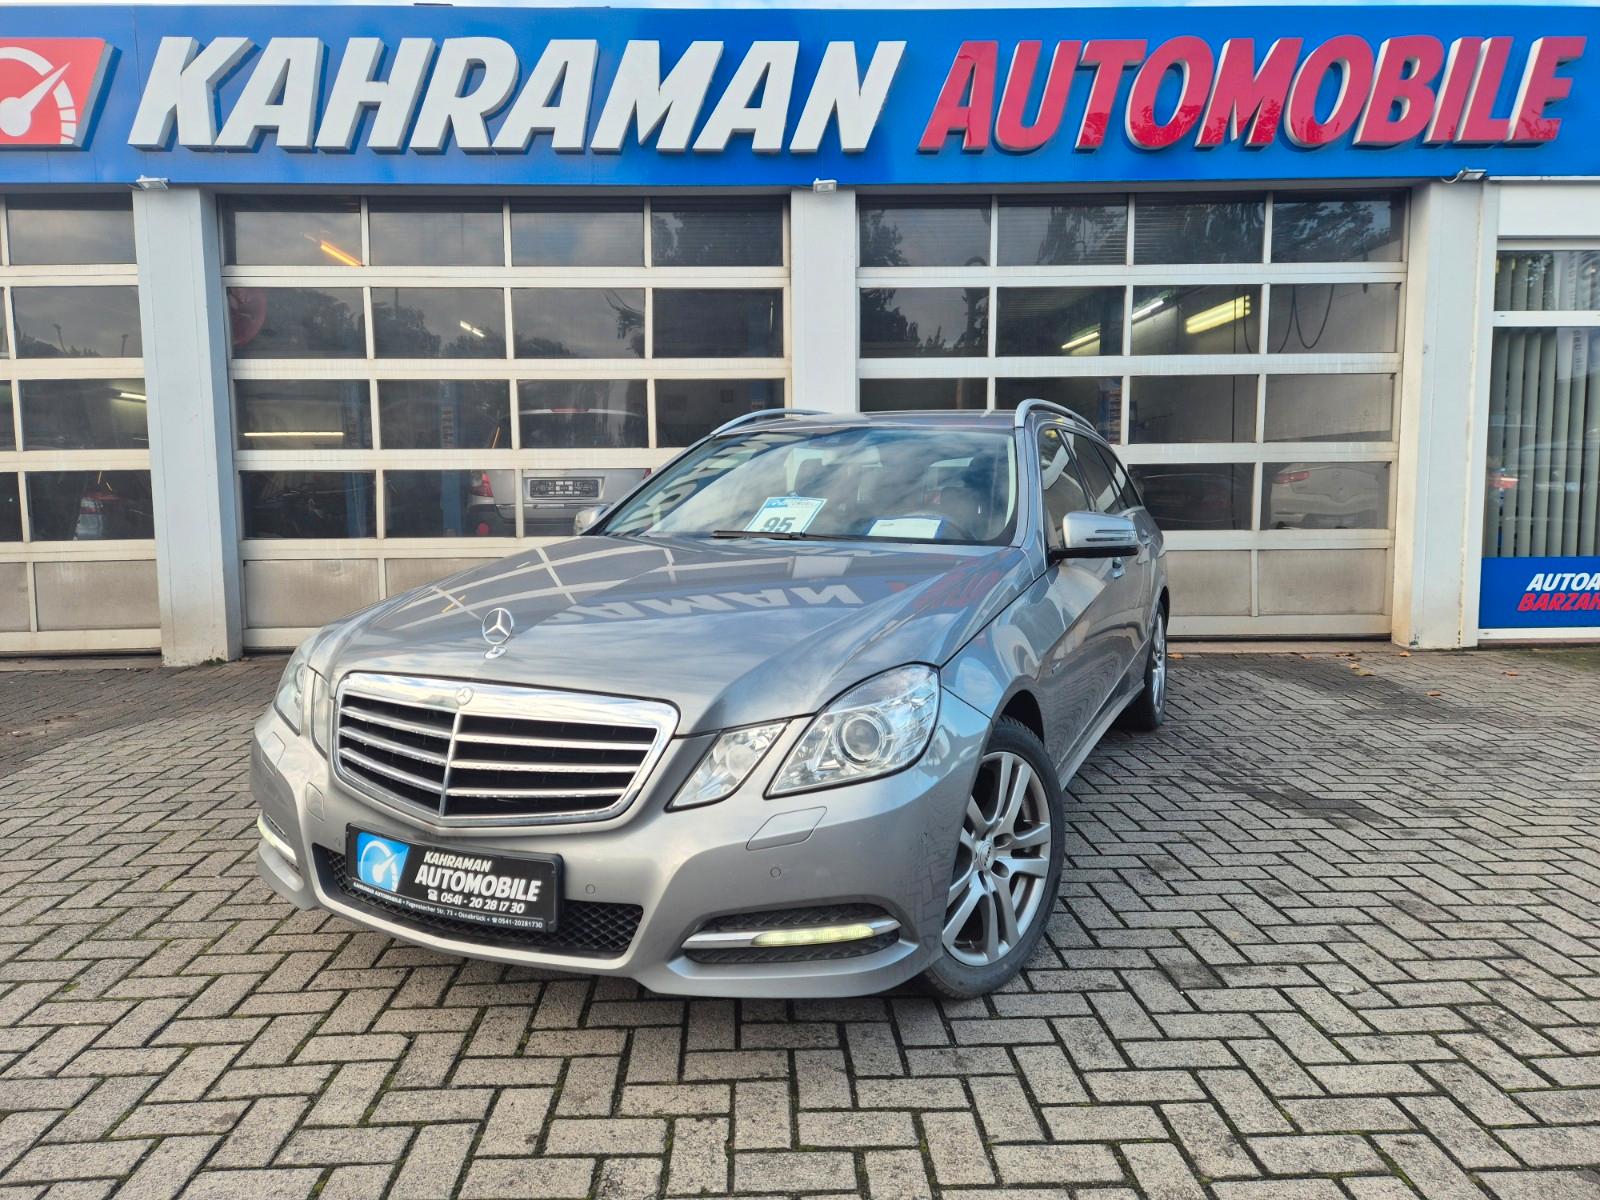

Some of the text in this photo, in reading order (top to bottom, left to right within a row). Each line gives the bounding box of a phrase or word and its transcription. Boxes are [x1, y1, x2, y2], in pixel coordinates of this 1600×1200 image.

[127, 35, 1587, 152] KAHRAMAN AUTOMOBILE
[760, 517, 796, 532] 95
[424, 851, 492, 873] KAHRAMAN
[414, 864, 541, 902] AUTOMOBILE
[440, 892, 463, 906] 0541
[469, 896, 483, 909] 20
[484, 899, 498, 911] 28
[498, 901, 510, 912] 17
[510, 902, 525, 914] 30
[458, 911, 485, 922] Osnabrück
